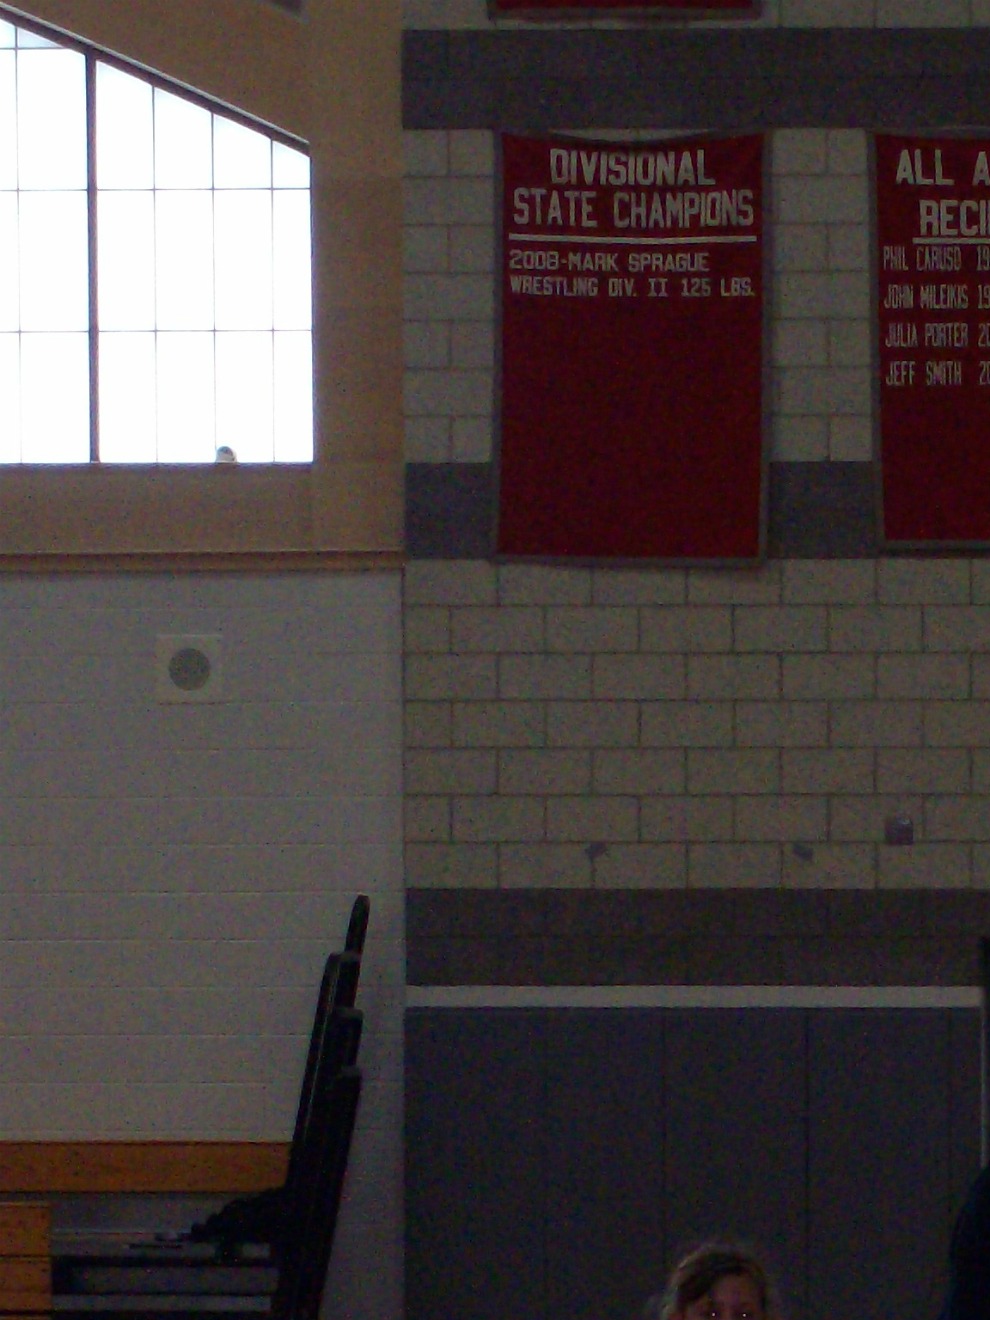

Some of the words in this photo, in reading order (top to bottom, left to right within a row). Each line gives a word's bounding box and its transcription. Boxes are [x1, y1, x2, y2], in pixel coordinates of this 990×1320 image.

[550, 148, 716, 186] DIVISIONAL
[896, 149, 955, 186] ALL
[513, 187, 599, 228] STATE
[613, 189, 755, 229] CHAMPIONS
[628, 252, 710, 273] SPRAGUE
[883, 245, 909, 272] PHIL
[916, 245, 961, 272] CARUSO
[510, 274, 599, 297] WRESTLING
[608, 277, 637, 298] DIV.
[648, 277, 669, 298] II
[681, 277, 711, 298] 125
[720, 277, 755, 298] LBS.
[883, 283, 914, 310] JOHN
[885, 321, 918, 349] JULIA
[924, 321, 969, 348] PORTER
[885, 360, 916, 387] JEFF
[925, 360, 962, 387] SMITH
